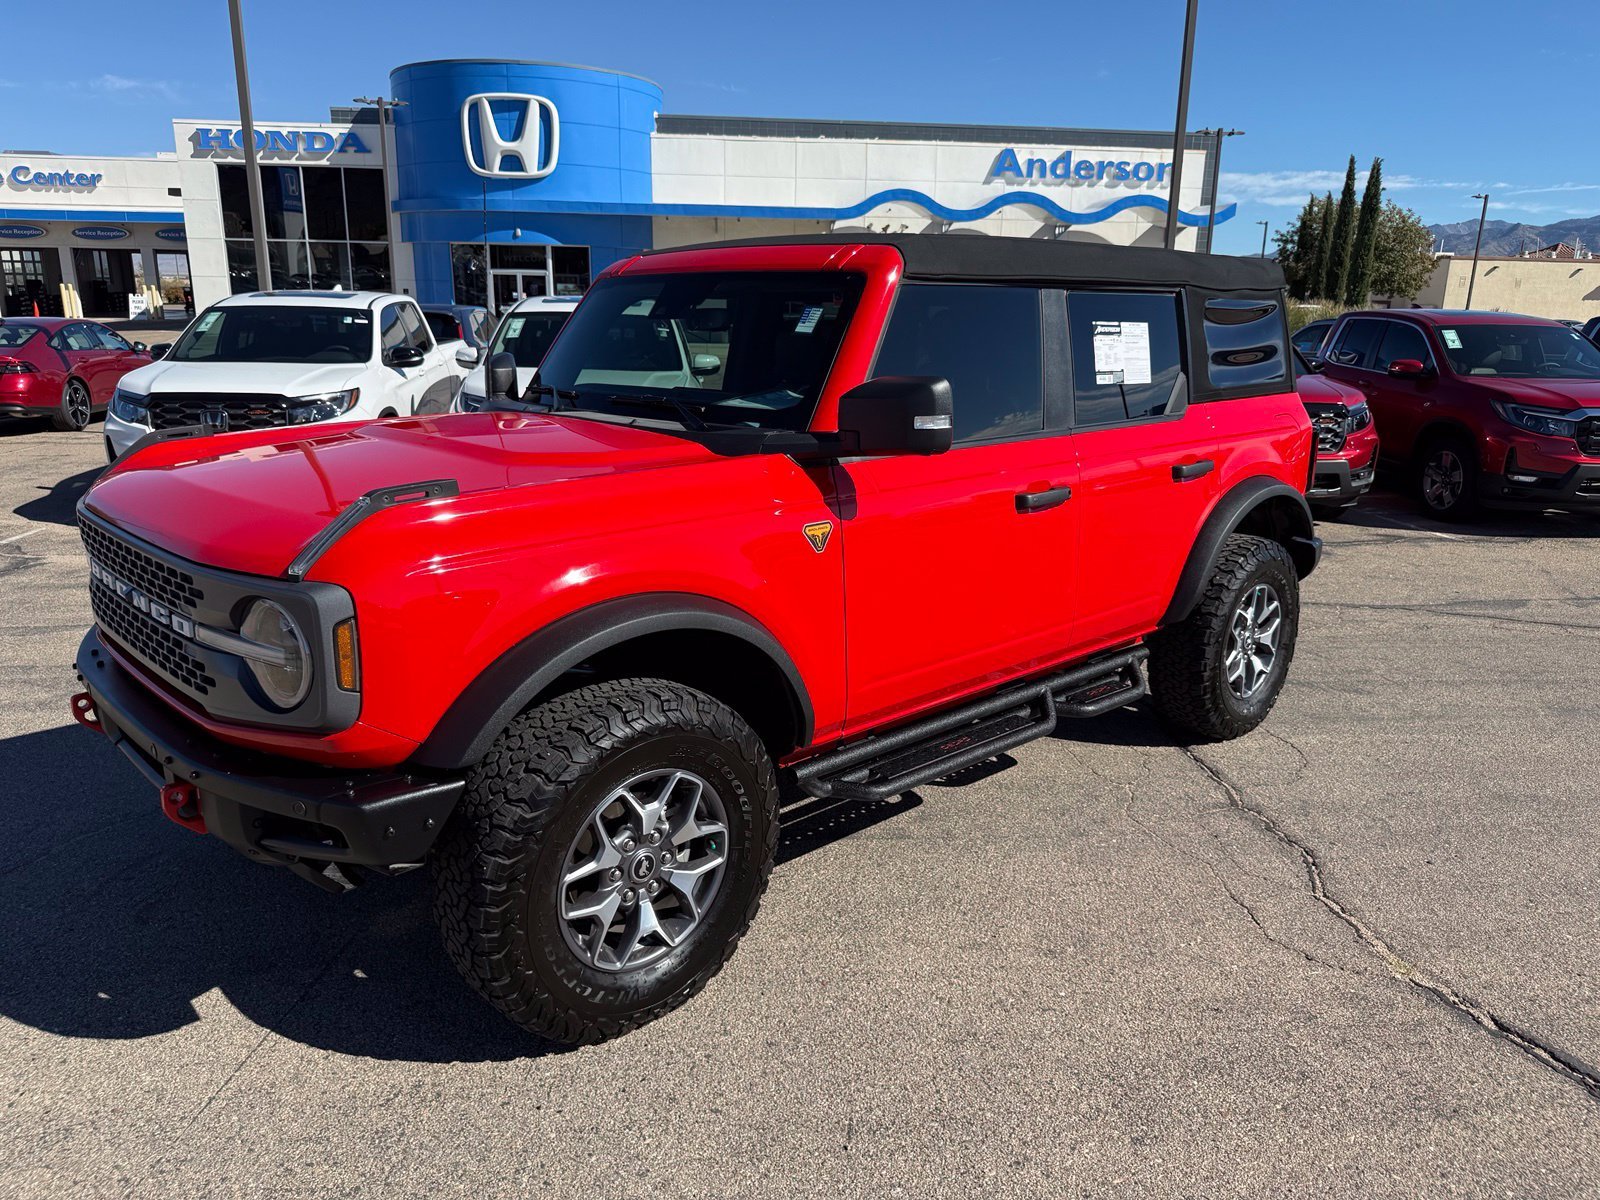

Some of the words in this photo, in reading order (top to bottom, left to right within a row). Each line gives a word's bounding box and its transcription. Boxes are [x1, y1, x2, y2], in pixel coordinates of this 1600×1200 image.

[195, 128, 372, 153] HONDA
[11, 165, 103, 186] Center
[991, 147, 1172, 182] Anderson
[91, 558, 194, 638] BRONCO
